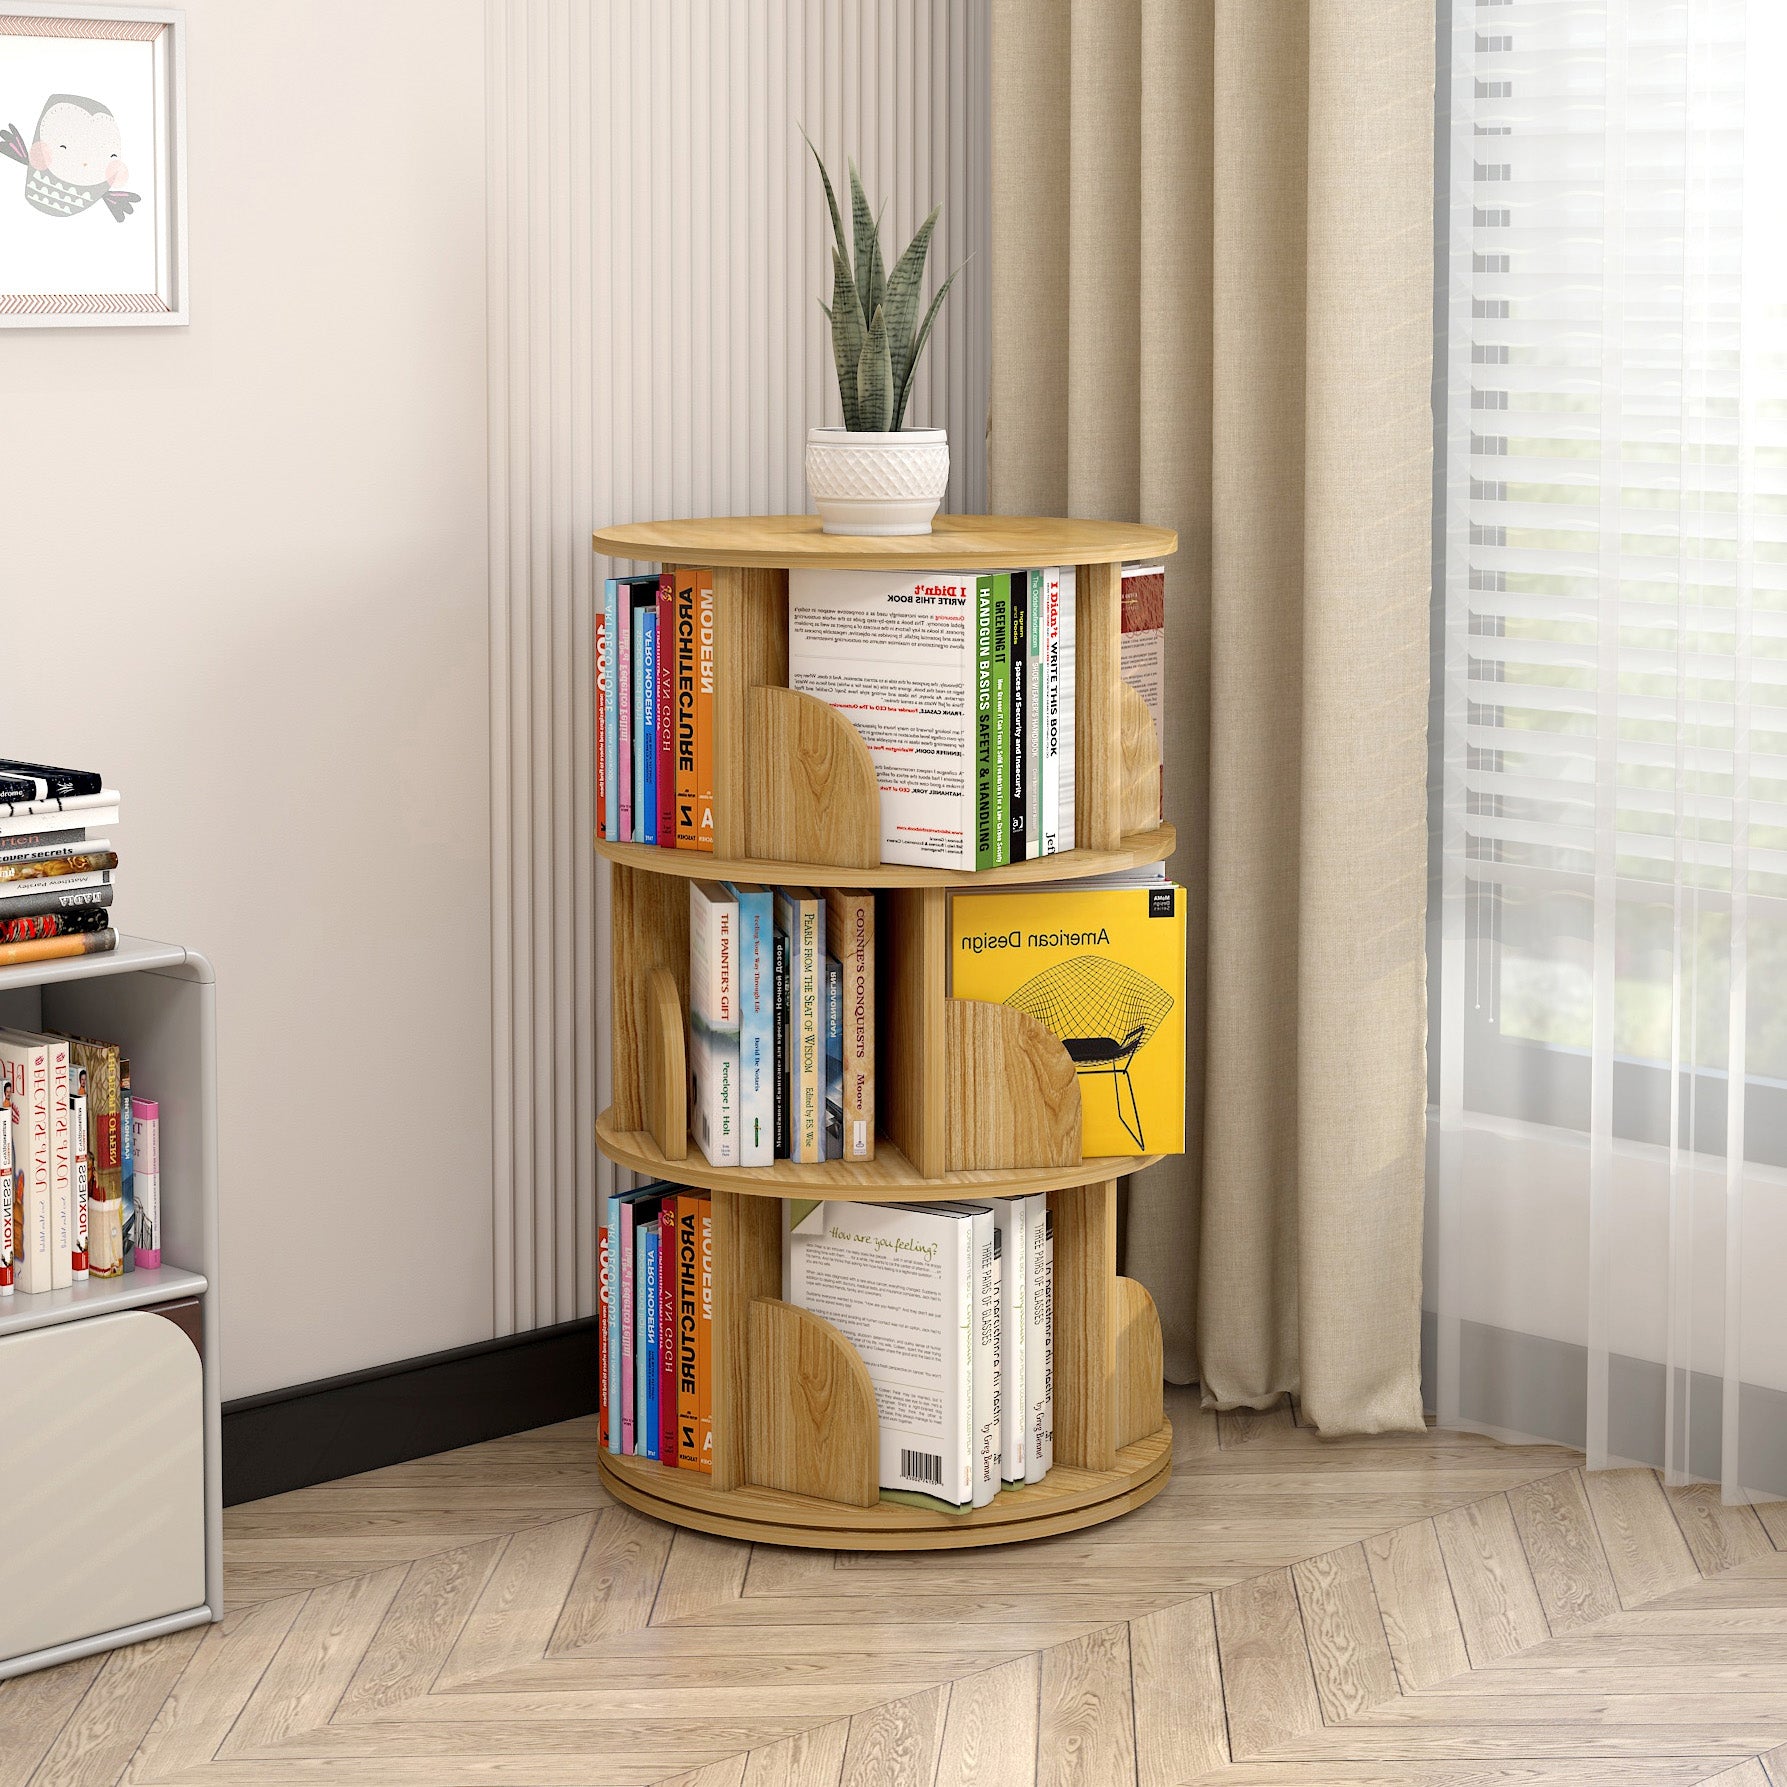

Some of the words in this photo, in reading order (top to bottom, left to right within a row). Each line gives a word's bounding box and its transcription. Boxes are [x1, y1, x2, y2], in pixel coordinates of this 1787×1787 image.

[980, 588, 990, 657] HANDGUN
[995, 600, 1005, 651] GREENING
[995, 654, 1005, 663] IT
[980, 662, 990, 710] BASICS
[1014, 692, 1022, 701] of
[980, 715, 989, 762] SAFETY
[980, 768, 989, 778] &
[980, 782, 989, 851] HANDLING
[31, 848, 73, 858] secrets
[17, 882, 46, 890] Parsley
[49, 876, 88, 886] Matthew
[804, 914, 815, 945] PEARLS
[856, 909, 865, 972] CONNIE'S
[804, 948, 813, 972] FROM
[804, 975, 813, 992] THE
[804, 995, 815, 1018] SEAT
[856, 976, 865, 1058] CONQUESTS
[804, 1020, 813, 1031] OF
[754, 1058, 760, 1066] De
[804, 1035, 815, 1073] WISDOM
[721, 1062, 730, 1104] Penelope
[856, 1074, 865, 1110] Moore
[721, 1116, 730, 1135] Holt
[804, 1109, 813, 1117] by
[829, 1227, 851, 1240] How
[854, 1235, 871, 1244] are
[874, 1237, 892, 1252] you
[895, 1238, 937, 1262] feeling?
[1035, 1223, 1044, 1250] THREE
[982, 1241, 992, 1269] THREE
[1035, 1250, 1044, 1275] PAIRS
[982, 1270, 992, 1295] PAIRS
[1035, 1276, 1044, 1286] OF
[982, 1296, 992, 1306] OF
[1035, 1289, 1044, 1326] GLASSES
[982, 1309, 992, 1346] GLASSES
[1034, 1401, 1044, 1411] by
[981, 1423, 992, 1433] by
[1034, 1413, 1044, 1432] Greg
[981, 1435, 992, 1454] Greg
[1036, 1432, 1044, 1459] Bennet
[984, 1456, 992, 1482] Bennet
